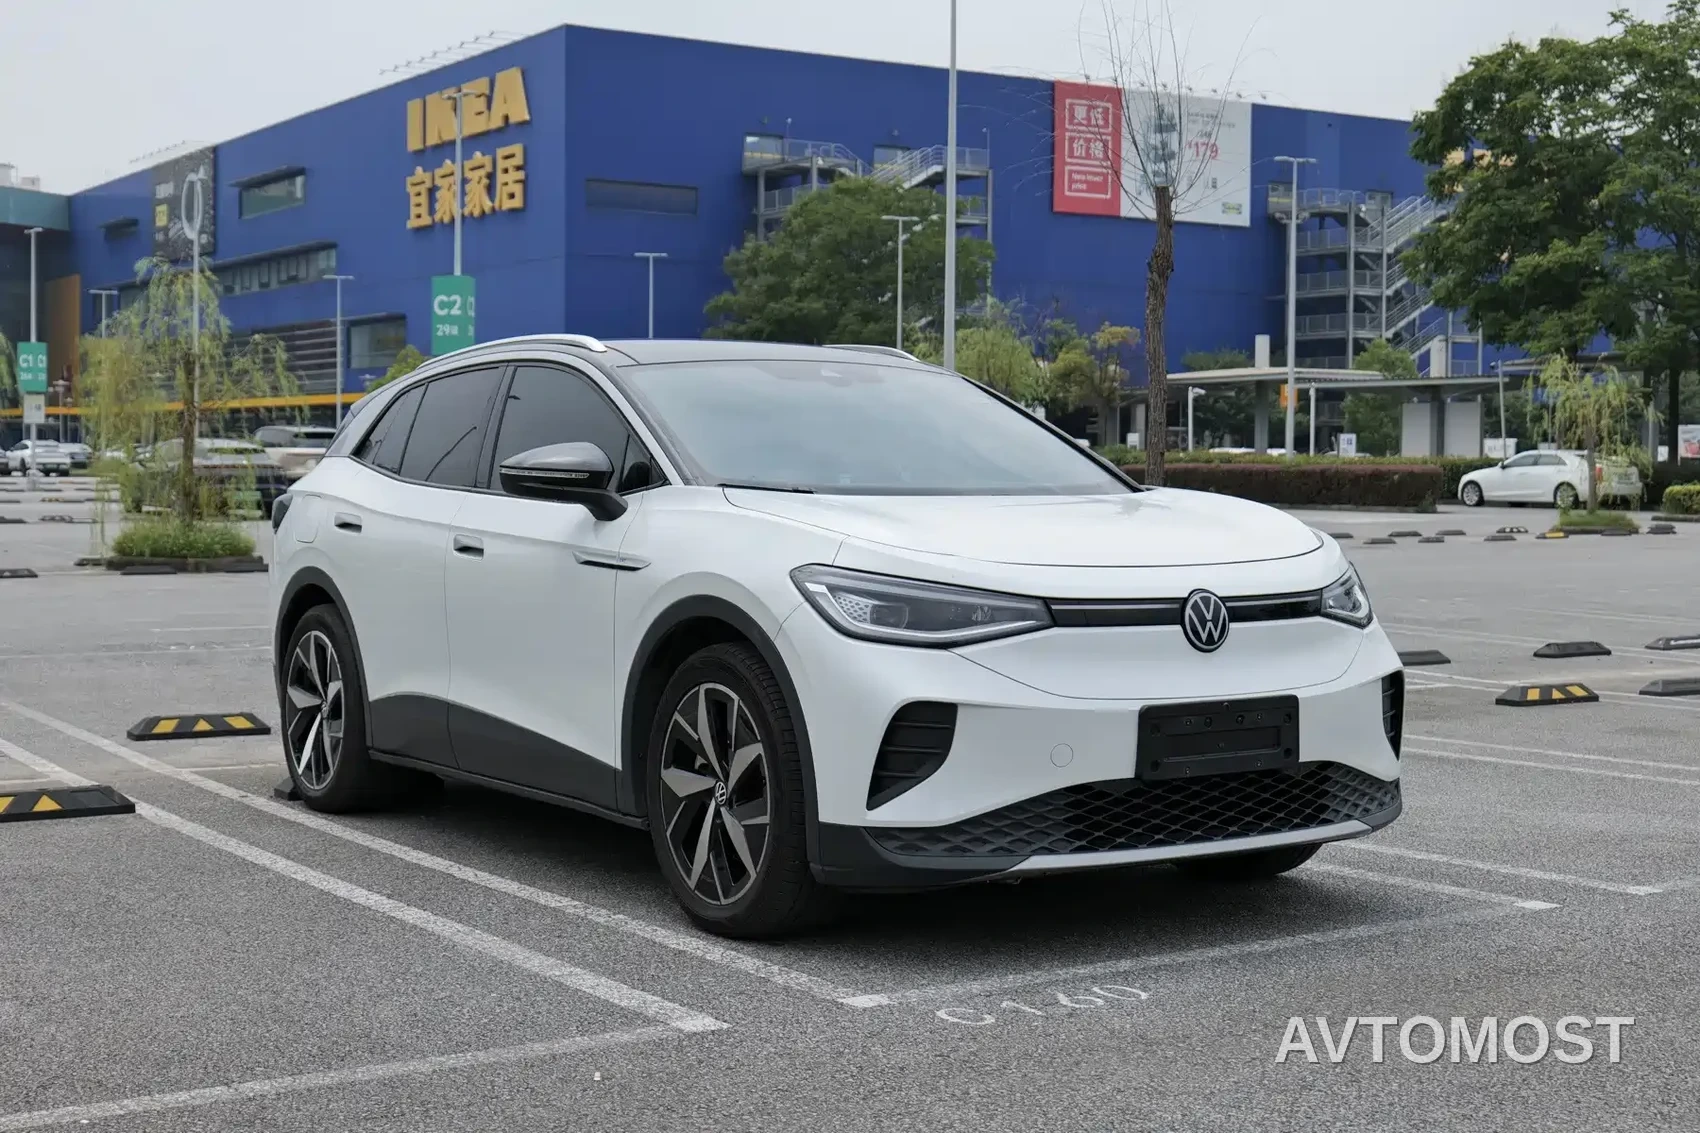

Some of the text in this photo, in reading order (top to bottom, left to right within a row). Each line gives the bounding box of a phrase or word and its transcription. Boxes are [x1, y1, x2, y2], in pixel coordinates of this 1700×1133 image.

[407, 66, 530, 153] IKEA
[1072, 138, 1104, 159] 价格
[406, 143, 525, 229] 宜家家居
[433, 294, 462, 316] C2
